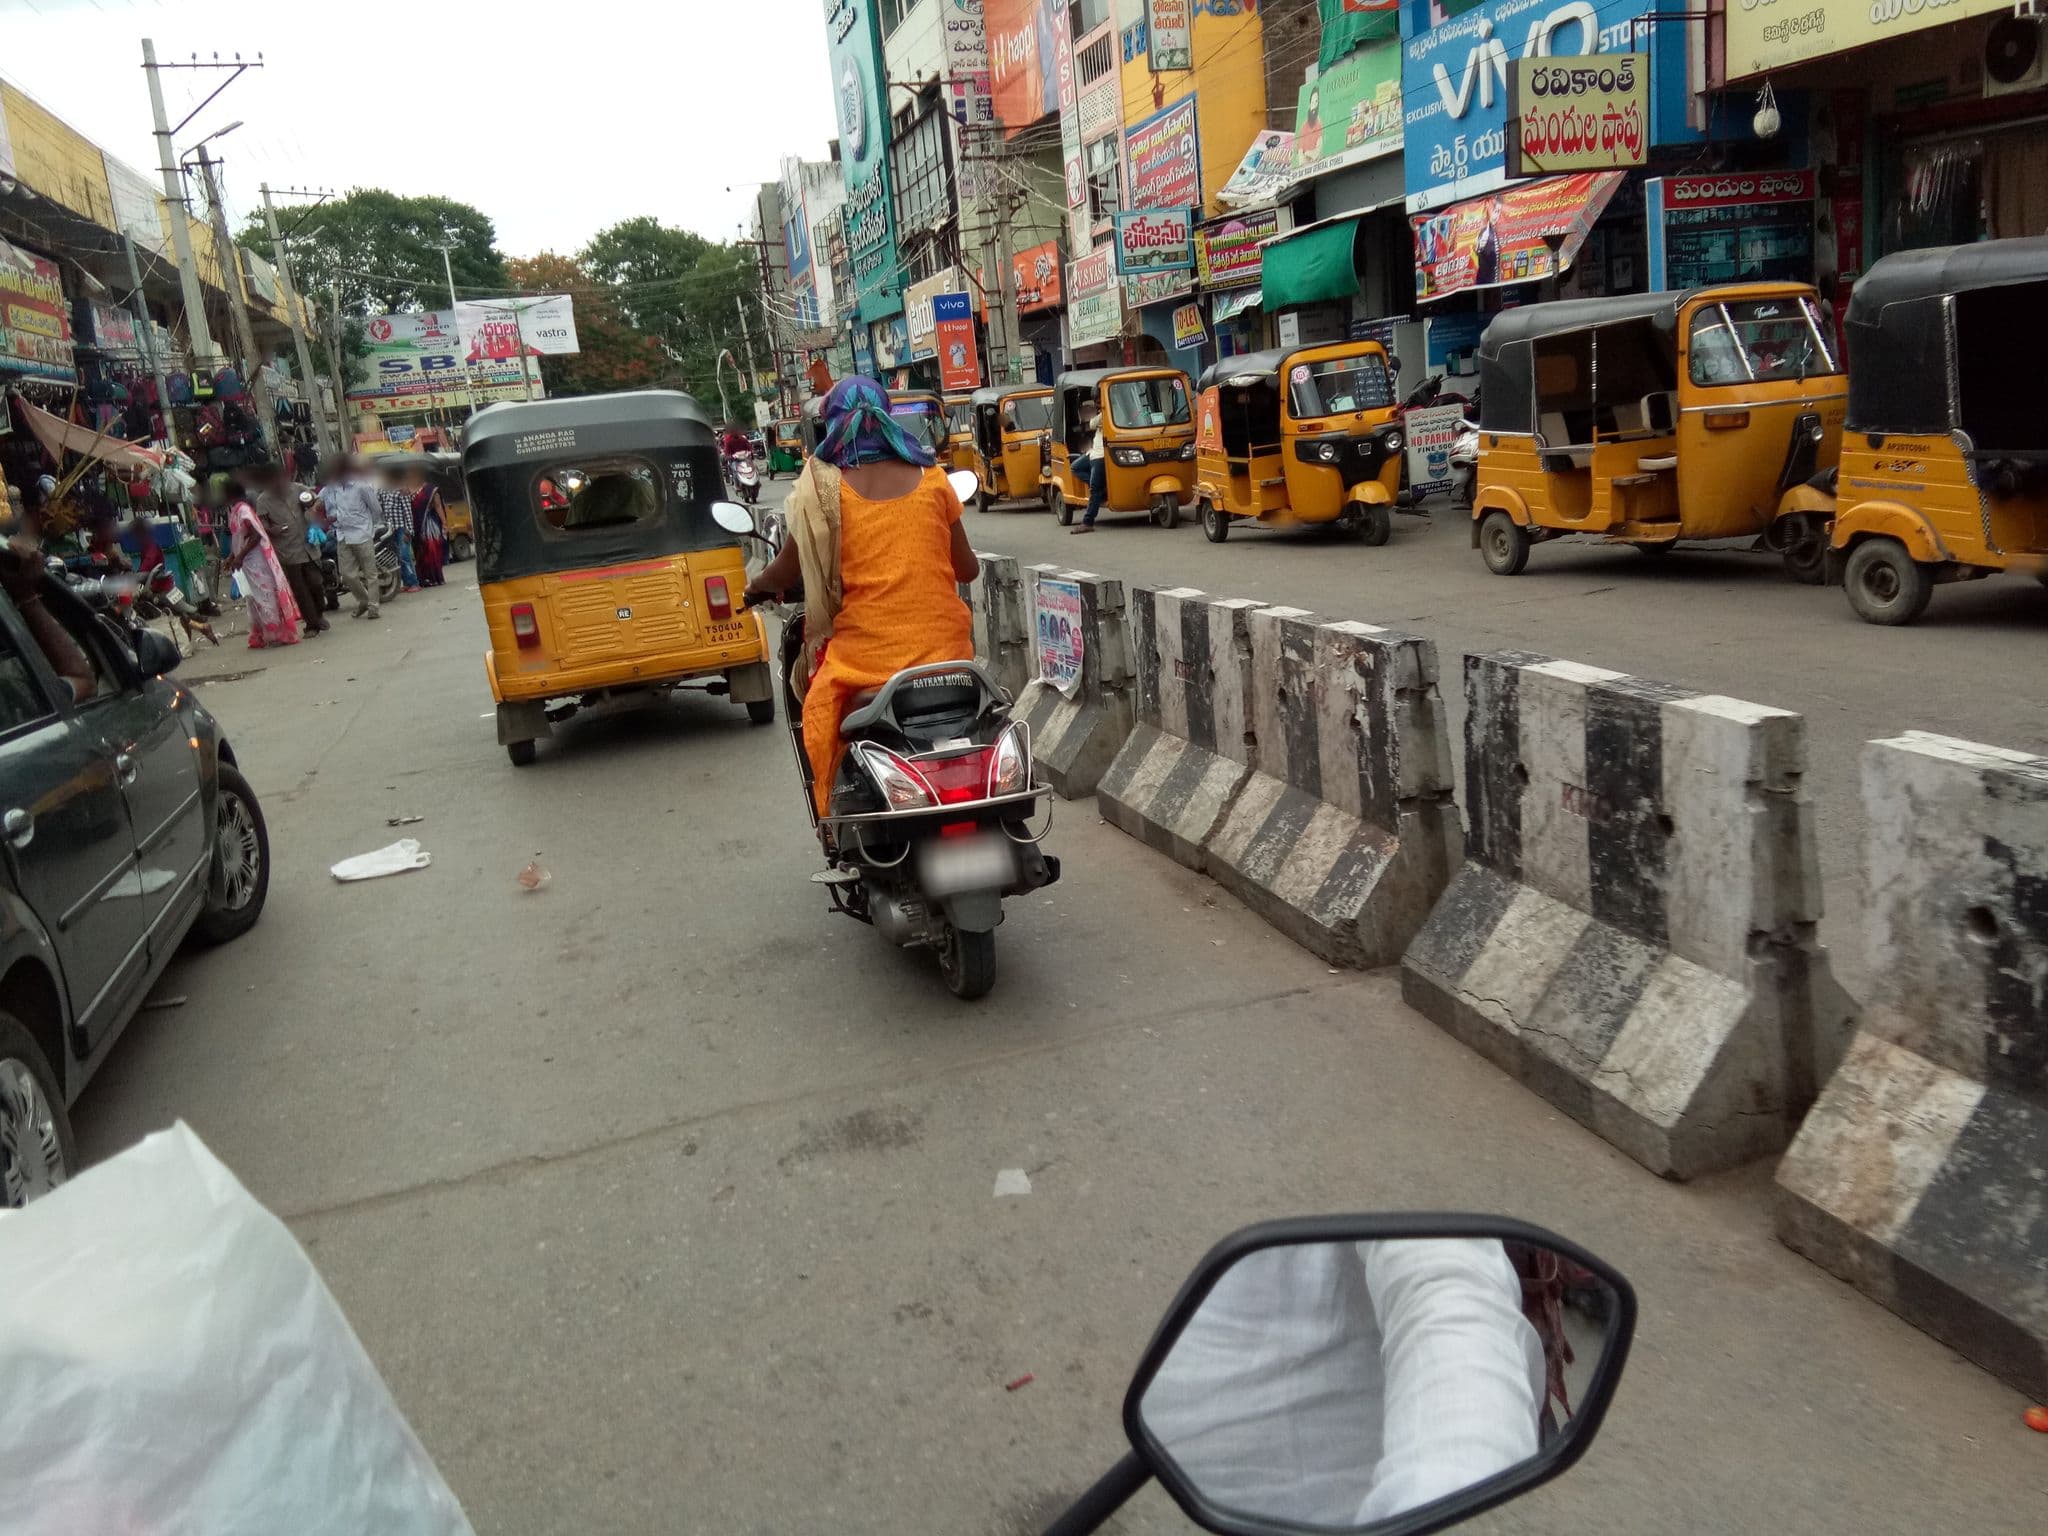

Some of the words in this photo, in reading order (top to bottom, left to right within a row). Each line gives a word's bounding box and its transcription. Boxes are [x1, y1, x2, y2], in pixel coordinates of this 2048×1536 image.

[1600, 10, 1657, 53] STORE
[1531, 57, 1636, 98] రవికాంత్
[1522, 104, 1599, 158] మందుల
[1601, 98, 1645, 163] షాపు
[1674, 179, 1756, 201] మందుల
[1759, 174, 1805, 198] షాపు
[1123, 215, 1186, 254] భోజనం
[940, 301, 965, 310] vivo
[536, 328, 568, 338] vastra
[360, 396, 446, 411] B.Tech
[1410, 435, 1423, 448] NO
[1418, 445, 1436, 454] FINE
[671, 470, 692, 479] 703
[618, 610, 631, 619] RE
[705, 622, 744, 635] TS04UA
